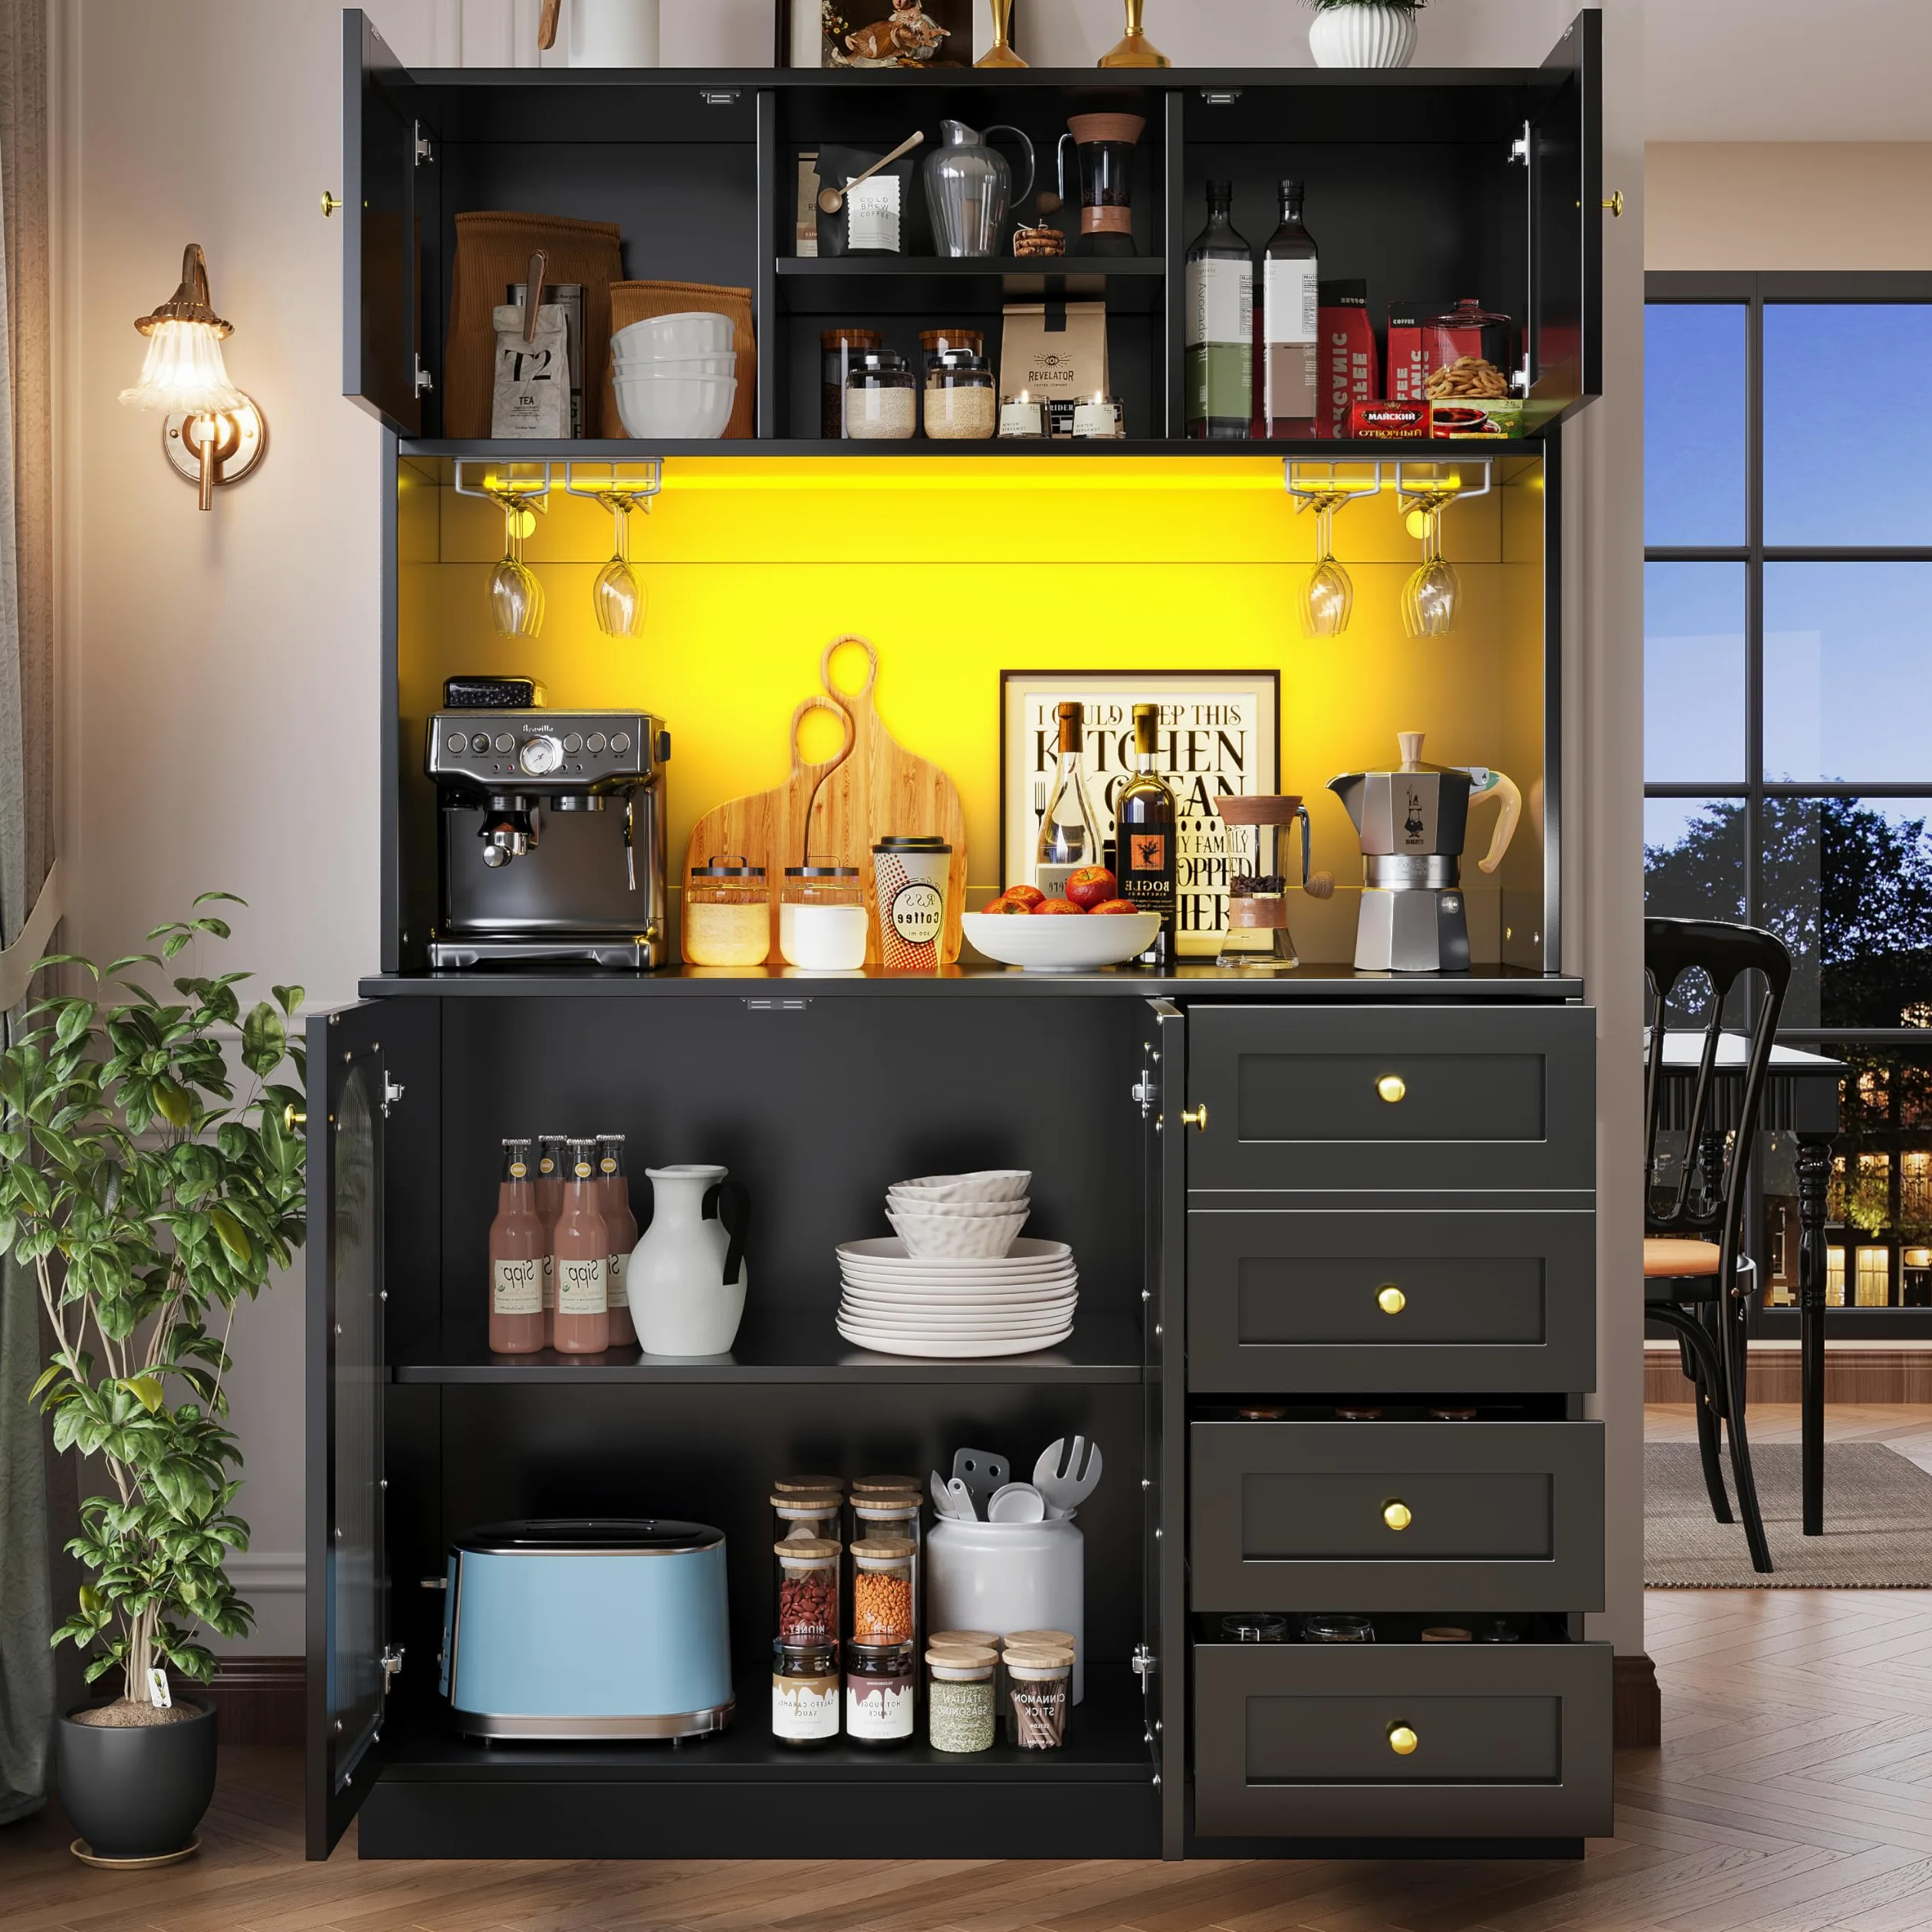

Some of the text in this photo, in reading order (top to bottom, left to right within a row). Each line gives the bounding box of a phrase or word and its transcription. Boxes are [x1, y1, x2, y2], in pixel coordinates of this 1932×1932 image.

[1198, 282, 1207, 340] Avocado
[504, 350, 551, 382] T2
[1029, 370, 1073, 382] REVELATOR
[519, 396, 534, 405] TEA
[1038, 705, 1043, 725] I
[1191, 705, 1242, 725] THIS
